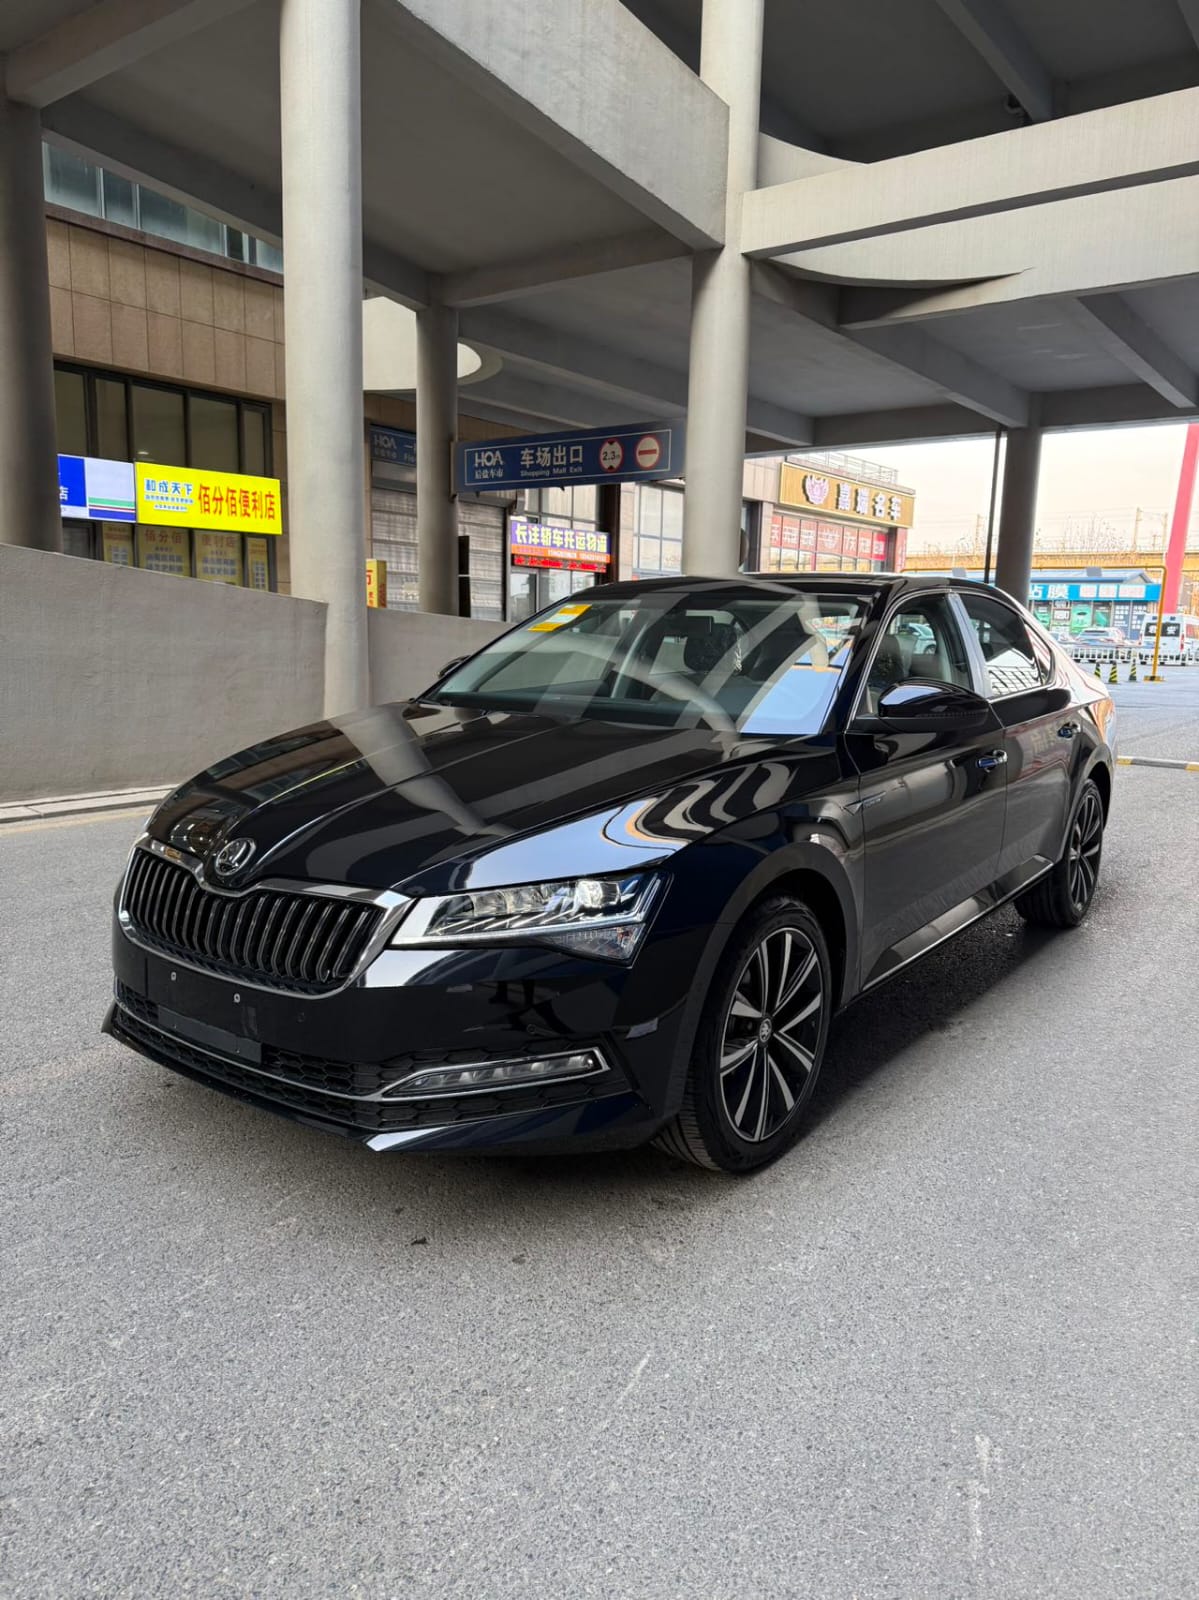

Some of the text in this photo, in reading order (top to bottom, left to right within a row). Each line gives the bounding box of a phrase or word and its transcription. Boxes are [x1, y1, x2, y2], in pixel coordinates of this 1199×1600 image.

[474, 451, 503, 467] HOA
[520, 445, 583, 468] 车场出口
[520, 469, 550, 477] Shopping
[553, 467, 567, 475] Mall
[198, 483, 276, 520] 佰分佰便利店
